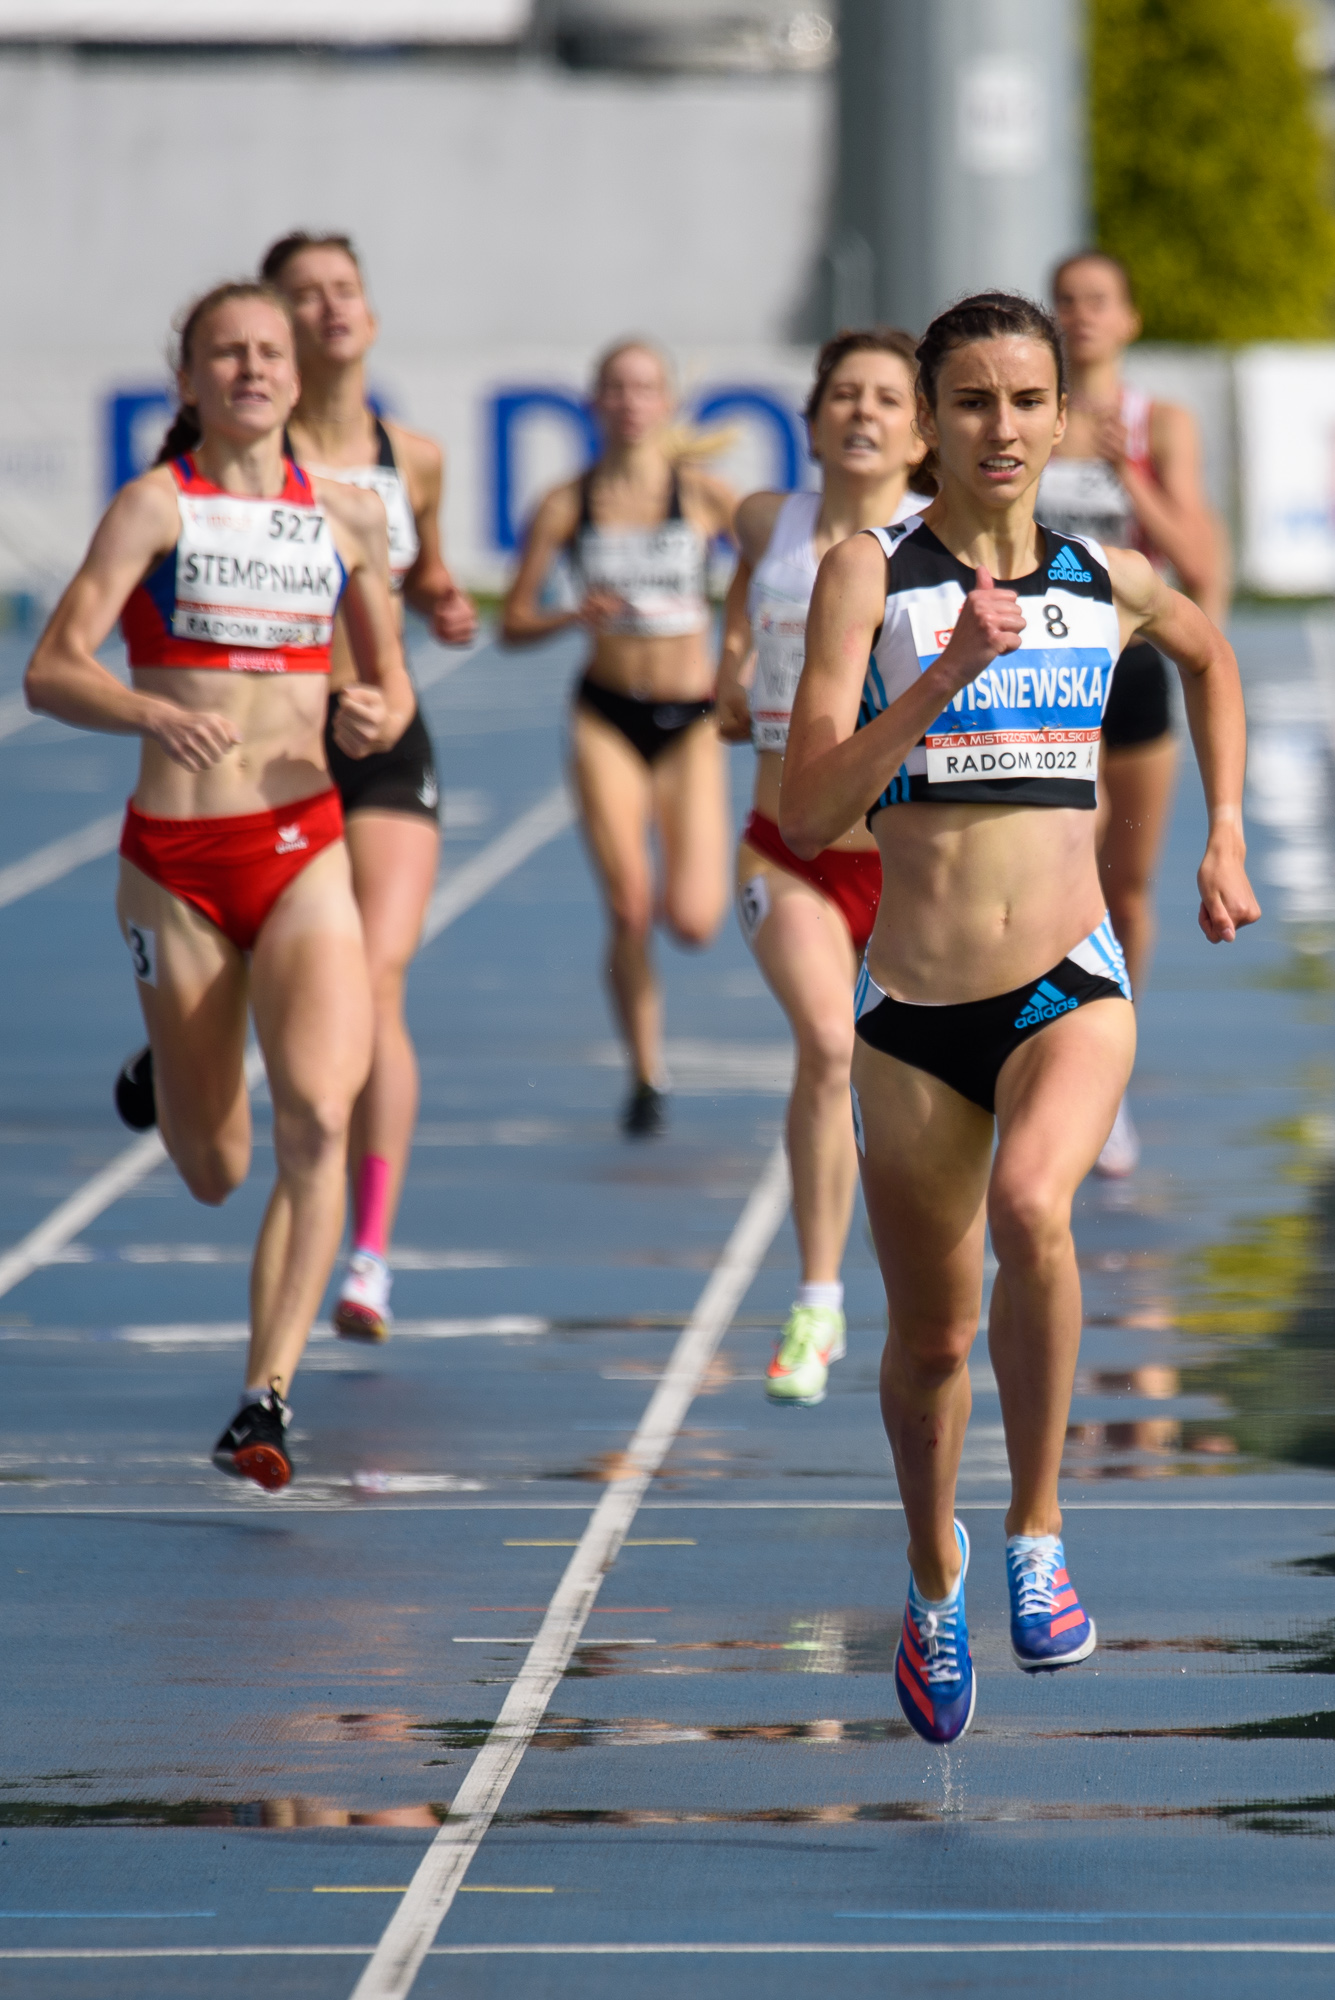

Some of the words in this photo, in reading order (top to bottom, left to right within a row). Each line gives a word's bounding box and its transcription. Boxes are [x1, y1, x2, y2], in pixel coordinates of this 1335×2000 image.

[268, 509, 324, 544] 527
[183, 553, 333, 597] STEMPNIAK
[1047, 567, 1093, 583] adidas
[187, 616, 259, 639] RADOM
[1042, 603, 1069, 639] 8
[932, 736, 967, 748] PZLA
[969, 732, 1046, 746] MISTRZOSTWA
[1048, 731, 1085, 743] POLSKI
[946, 752, 1032, 774] RADOM
[1036, 751, 1077, 770] 2022
[1014, 997, 1079, 1029] adidas
